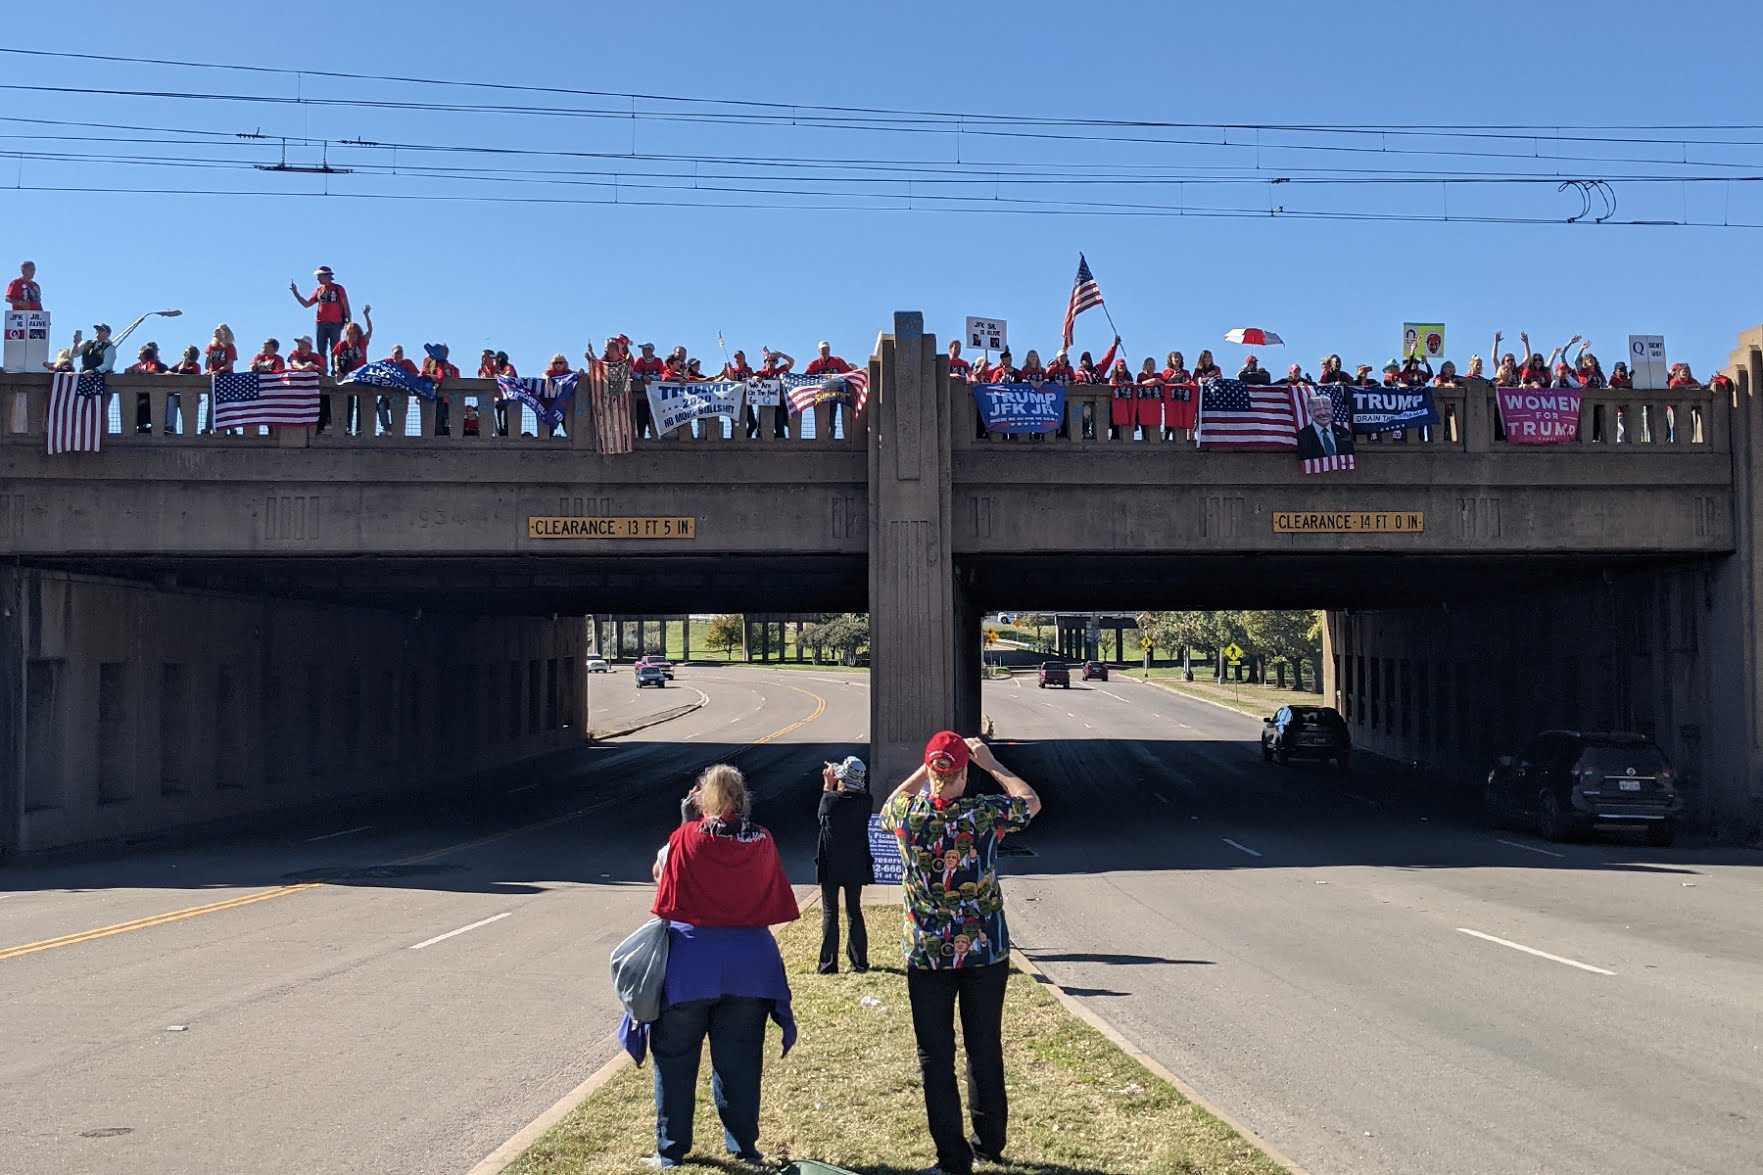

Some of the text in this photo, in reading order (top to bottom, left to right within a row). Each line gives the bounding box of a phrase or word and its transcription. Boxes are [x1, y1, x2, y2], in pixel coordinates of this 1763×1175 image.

[1632, 341, 1644, 356] Q
[658, 383, 735, 401] TRUMP
[986, 391, 1057, 405] TRUMP
[682, 395, 712, 409] 2020
[763, 396, 771, 404] Q
[1352, 393, 1423, 411] TRUMP
[1504, 395, 1580, 413] WOMEN
[663, 417, 674, 428] NO
[698, 404, 735, 415] BULLSHIT
[989, 403, 1059, 417] JFK JR.
[1536, 412, 1559, 420] FOR
[1507, 421, 1576, 436] TRUMP
[535, 520, 689, 535] CLEARANCE 13 FT 5 IN
[1278, 514, 1352, 529] CLEARANCE
[1360, 515, 1370, 528] 14
[1376, 515, 1388, 529] FT
[1407, 515, 1418, 529] IN
